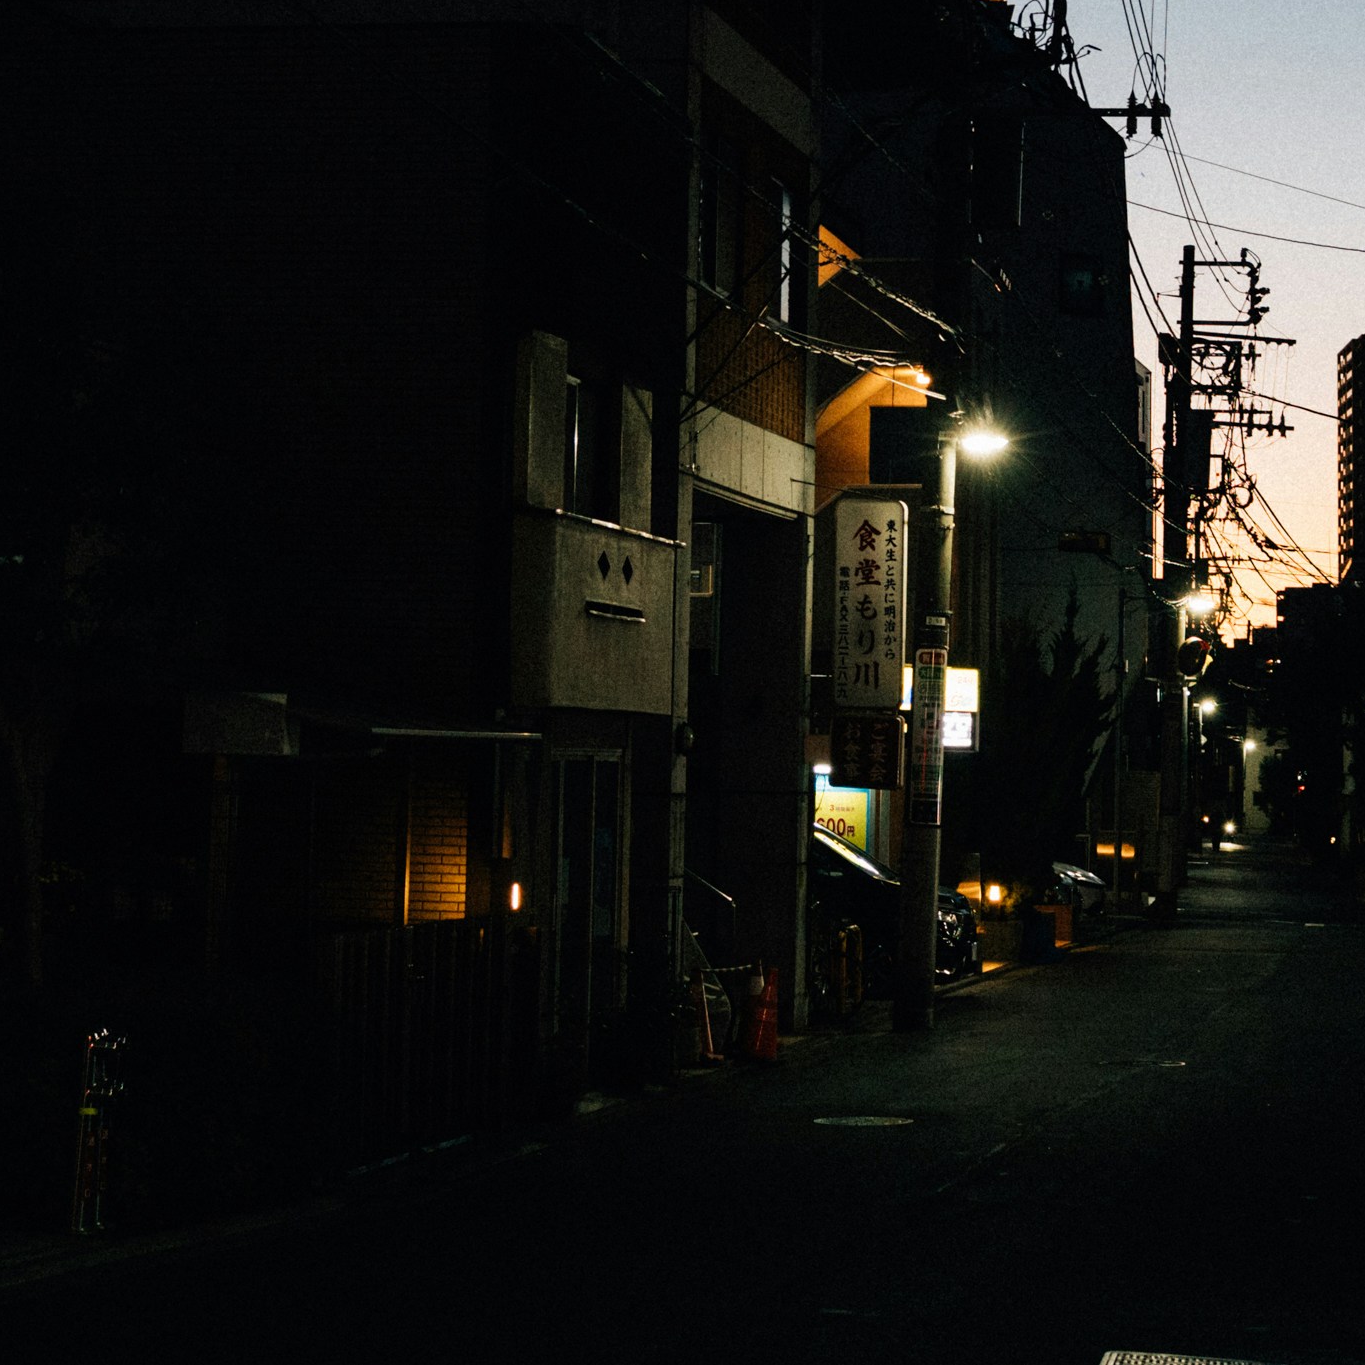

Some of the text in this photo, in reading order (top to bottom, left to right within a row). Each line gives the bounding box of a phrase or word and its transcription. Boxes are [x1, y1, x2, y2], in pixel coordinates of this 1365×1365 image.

[852, 519, 882, 690] 食堂もり川
[884, 519, 897, 660] 東大生と共に明治から
